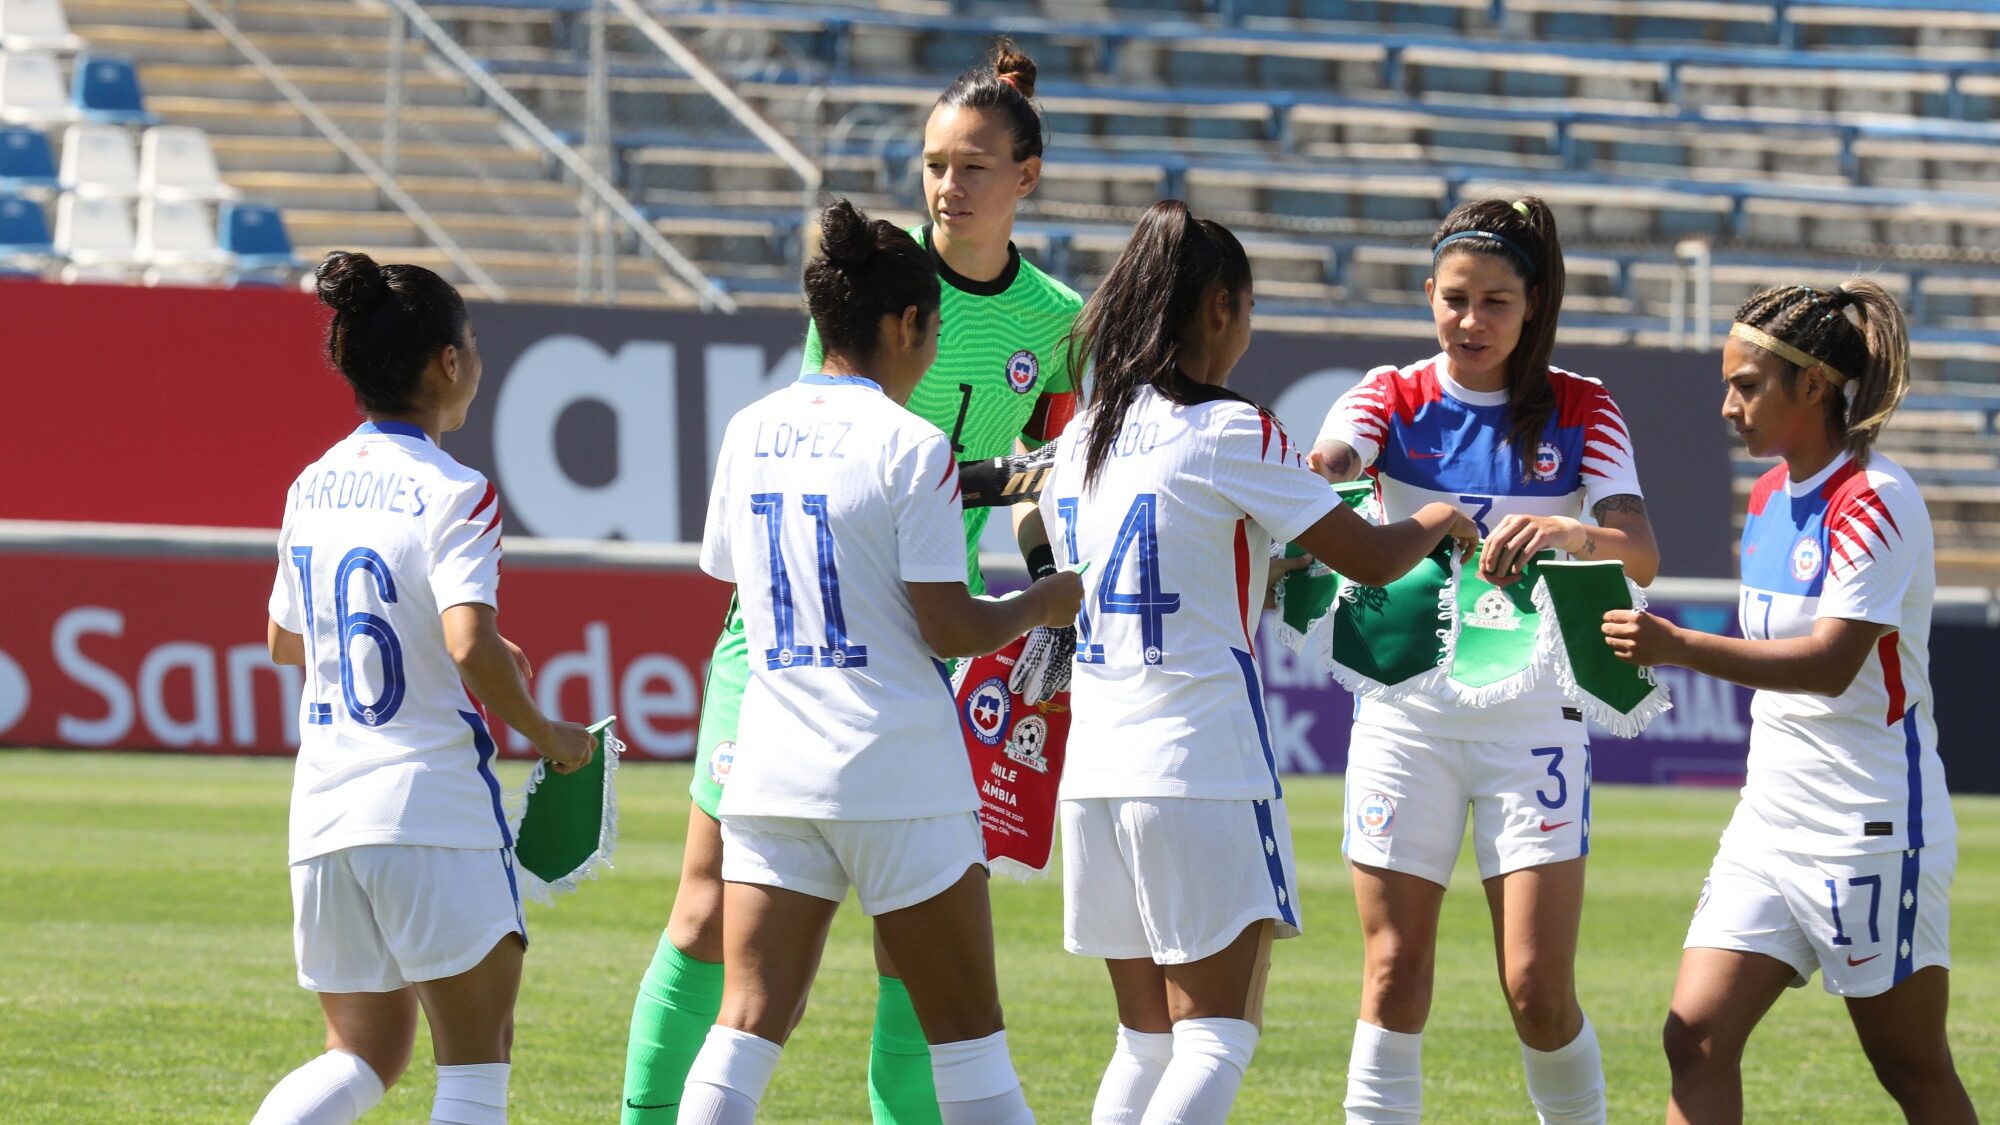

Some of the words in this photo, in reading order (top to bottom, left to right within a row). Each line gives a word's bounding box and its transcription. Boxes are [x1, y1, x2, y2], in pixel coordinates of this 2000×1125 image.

[754, 420, 853, 459] LOPEZ
[951, 383, 972, 453] 1
[1459, 495, 1493, 540] 3
[750, 492, 868, 671] 11
[1057, 493, 1181, 665] 14
[291, 546, 406, 727] 16
[1744, 590, 1773, 640] 17
[981, 779, 1018, 807] ZAMBIA
[1530, 747, 1567, 810] 3
[1825, 874, 1882, 945] 17
